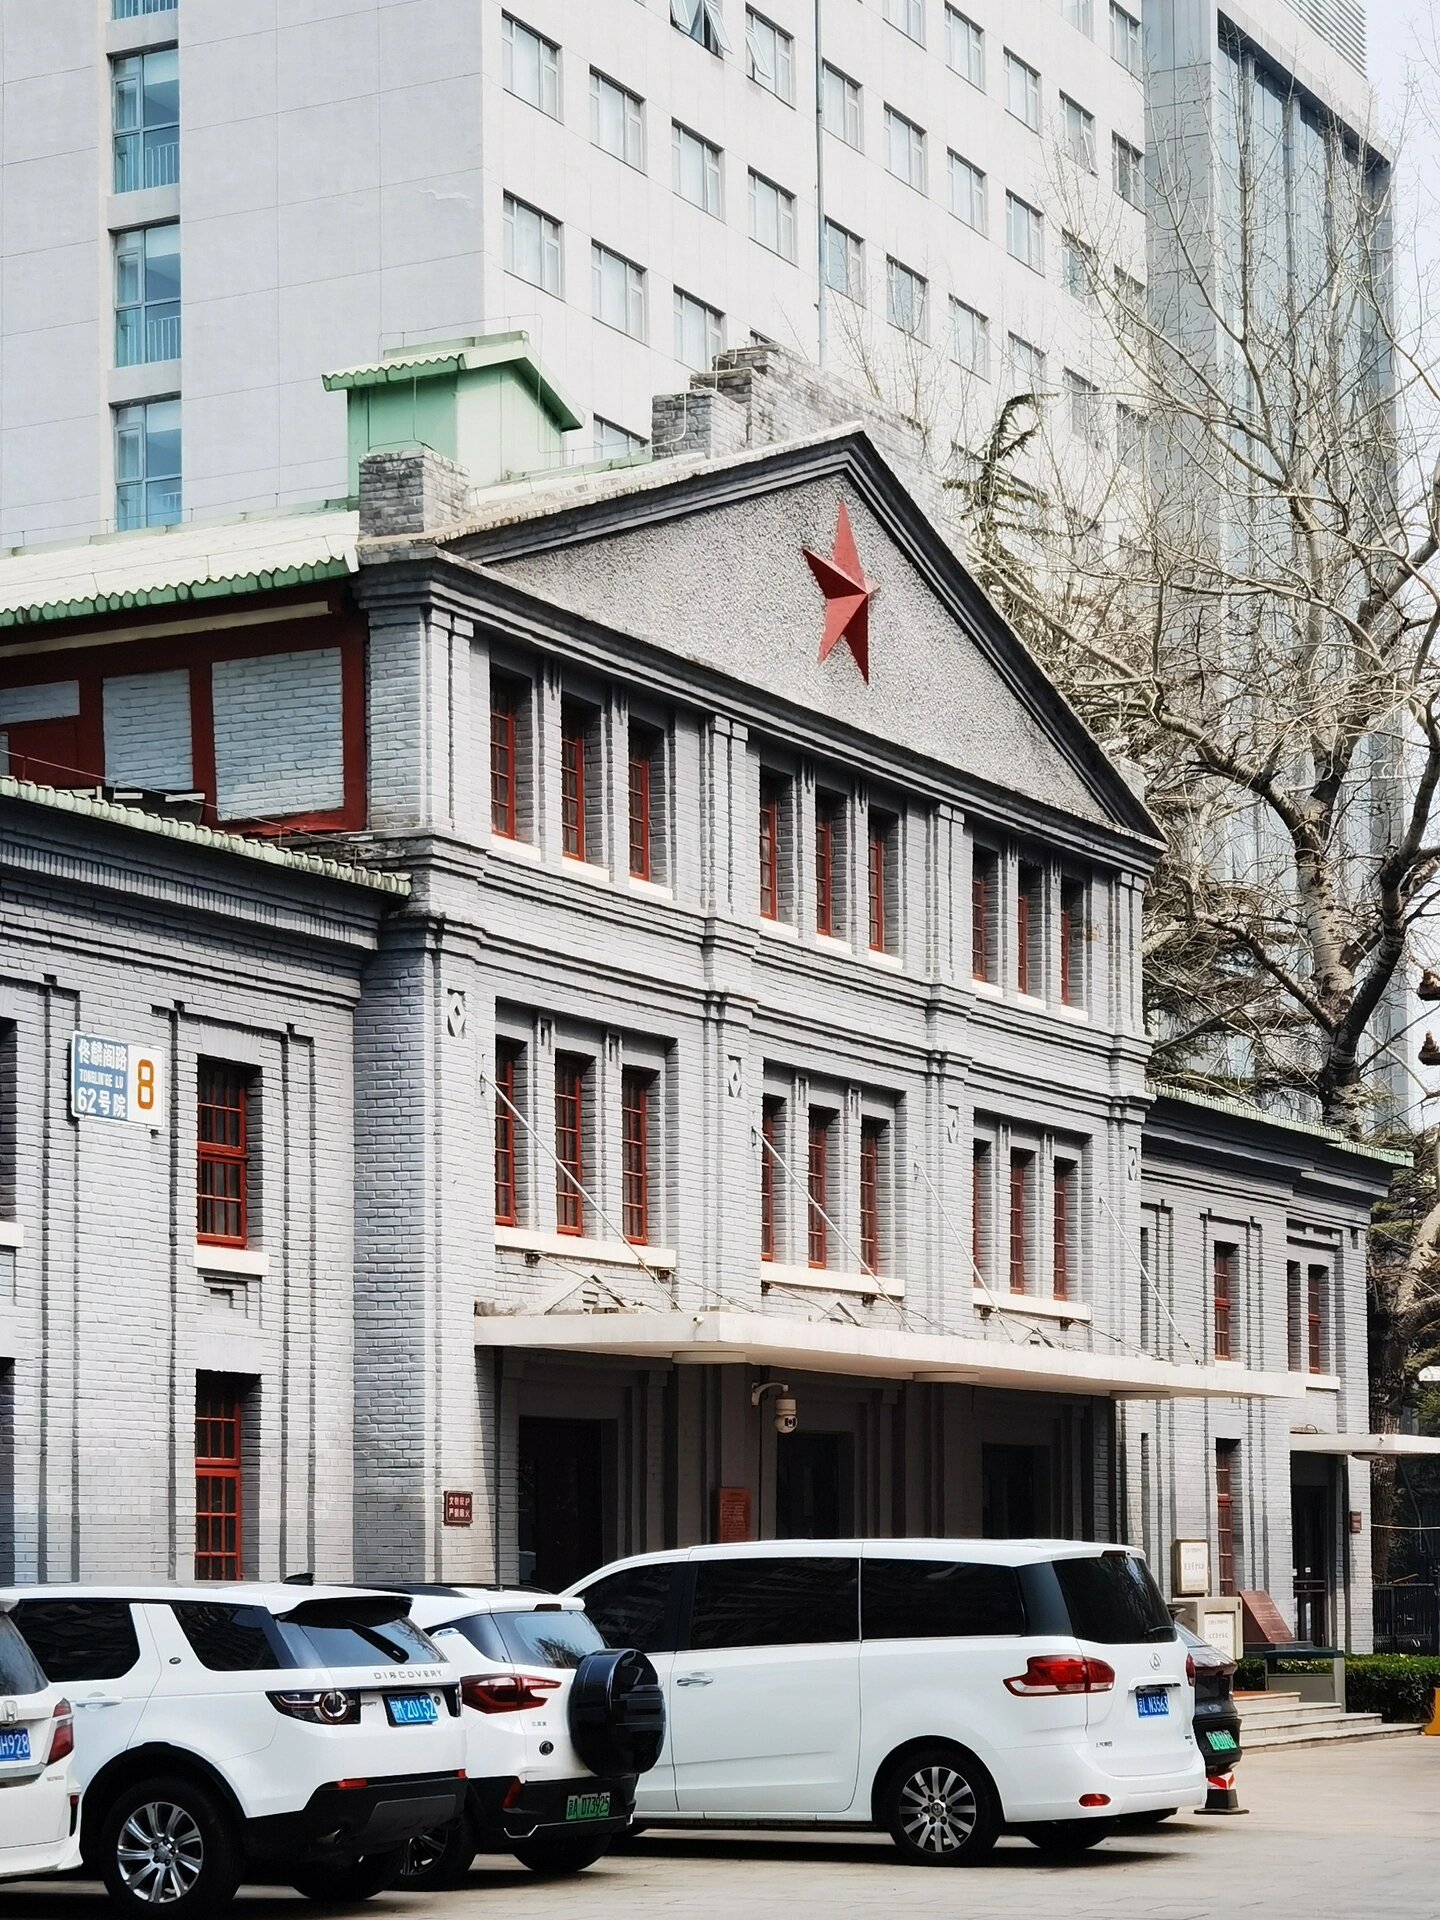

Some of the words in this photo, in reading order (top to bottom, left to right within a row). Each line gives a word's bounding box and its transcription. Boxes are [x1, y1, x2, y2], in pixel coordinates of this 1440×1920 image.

[115, 1075, 123, 1089] LU
[138, 1058, 154, 1110] 8
[78, 1087, 126, 1118] 62号院
[374, 1668, 442, 1680] DISCOVERY
[0, 1733, 30, 1756] H928
